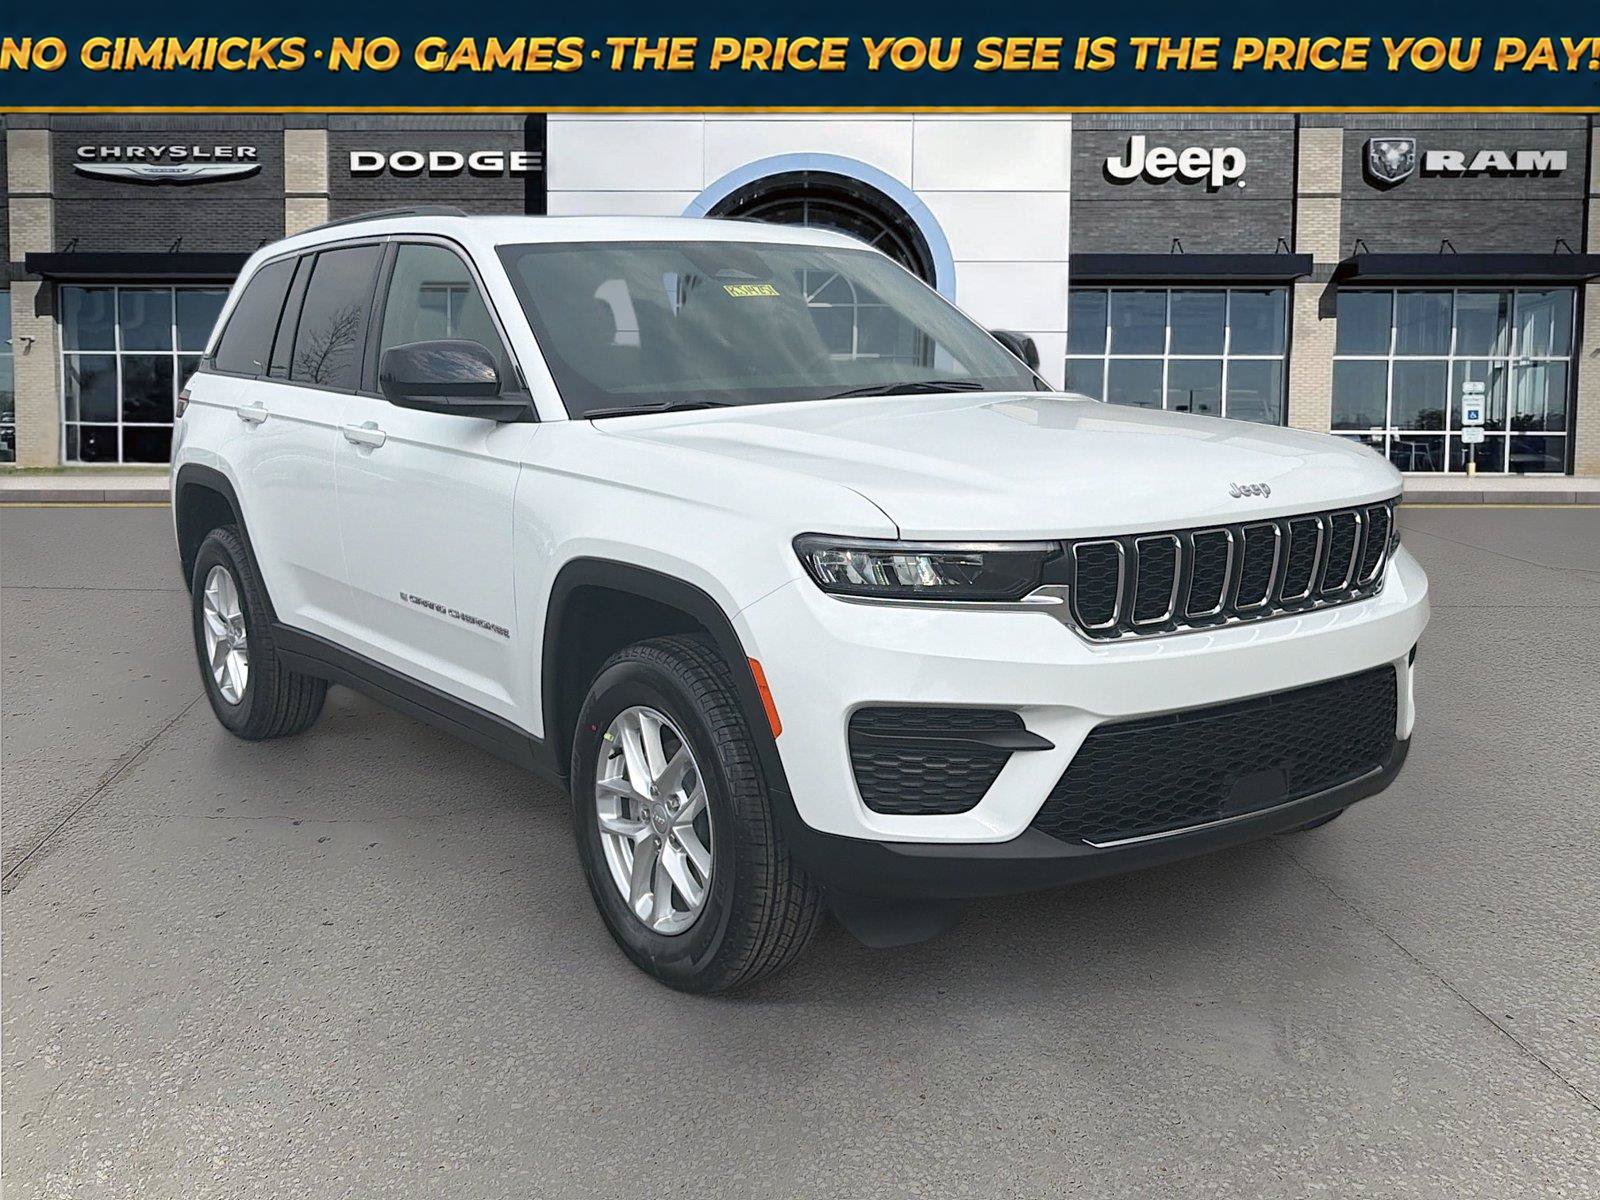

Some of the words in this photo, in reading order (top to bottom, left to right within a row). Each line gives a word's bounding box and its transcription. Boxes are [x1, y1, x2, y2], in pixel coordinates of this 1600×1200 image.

[76, 145, 257, 158] CHRYSLER
[350, 150, 542, 171] DODGE
[1106, 135, 1246, 188] Jeep
[1425, 150, 1567, 171] RAM
[1228, 482, 1271, 499] Jeep
